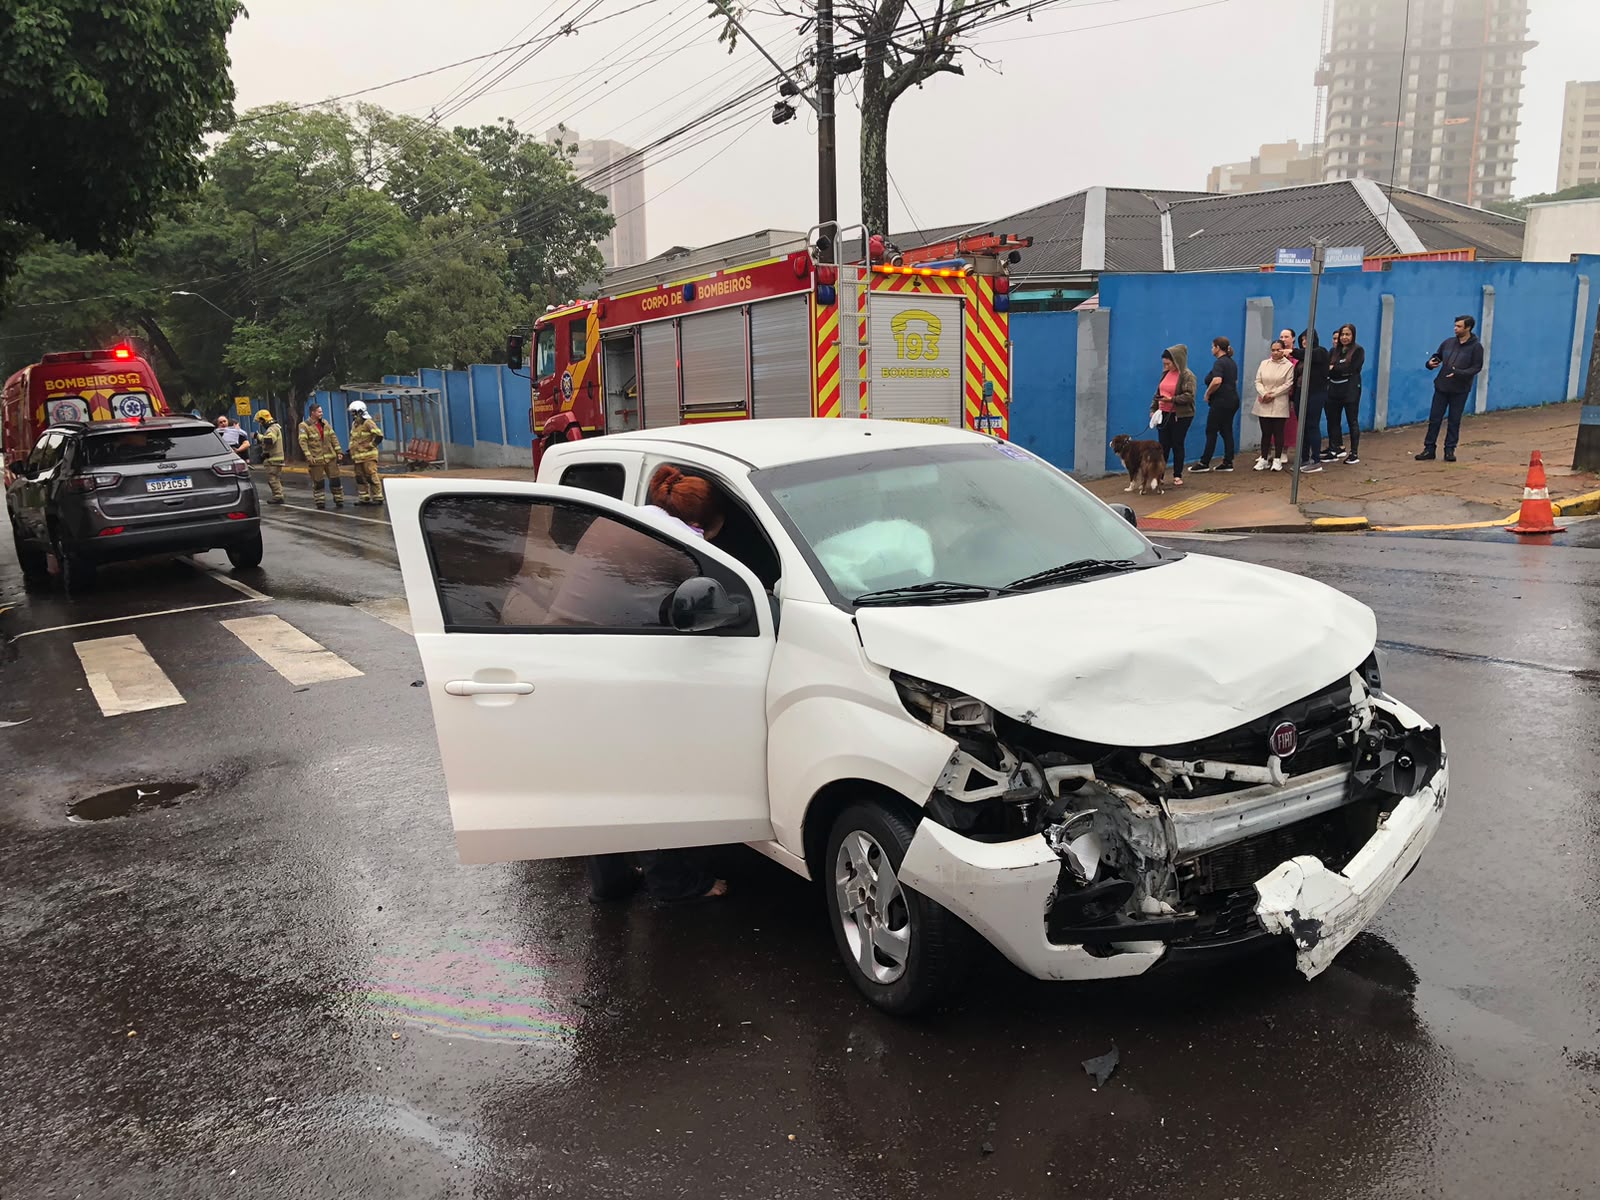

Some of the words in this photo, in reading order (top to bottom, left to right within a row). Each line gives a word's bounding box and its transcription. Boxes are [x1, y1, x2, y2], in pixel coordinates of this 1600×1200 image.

[641, 295, 669, 311] CORPO
[671, 292, 682, 305] DE
[698, 275, 752, 299] BOMBEIROS
[893, 333, 940, 360] 193
[881, 367, 950, 378] BOMBEIROS
[45, 374, 126, 390] BOMBEIROS
[150, 480, 188, 491] SDP1C53
[1277, 731, 1293, 750] FIAT
